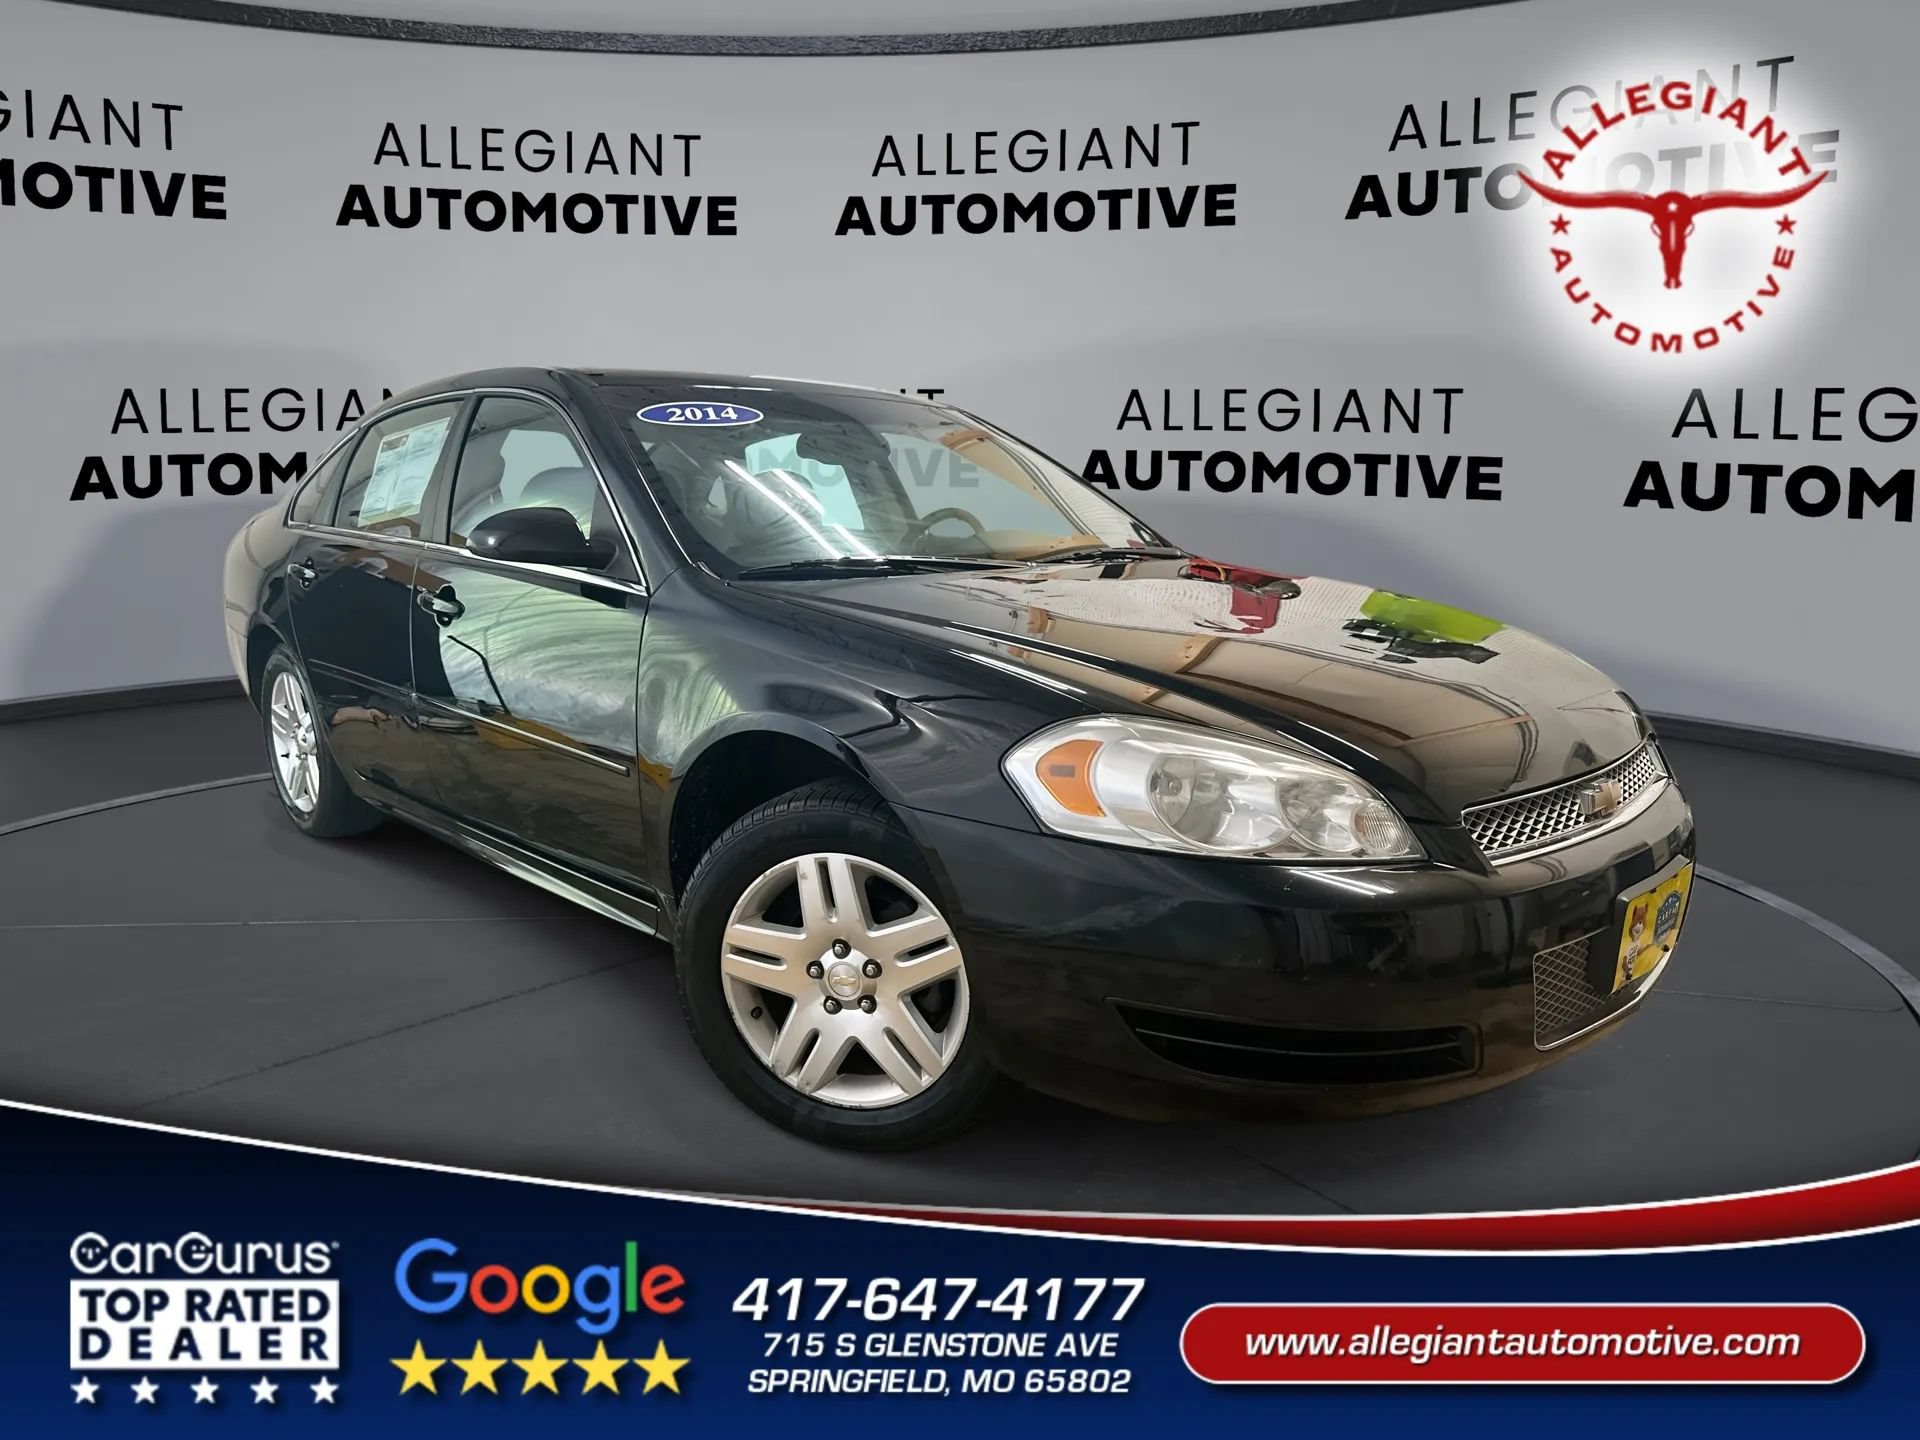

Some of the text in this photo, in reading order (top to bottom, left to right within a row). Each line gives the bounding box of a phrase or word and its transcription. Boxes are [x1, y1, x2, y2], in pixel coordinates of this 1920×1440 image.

[0, 89, 183, 151] IANT
[373, 122, 701, 177] ALLEGIANT
[871, 121, 1200, 177] ALLEGIANT
[1344, 129, 1840, 220] AUTOOTIE
[336, 184, 738, 235] AUTOMOTIVE
[834, 183, 1237, 236] AUTOMOTIVE
[111, 387, 394, 434] ALLEGIA
[666, 407, 739, 422] 2014
[1116, 388, 1465, 434] ALLEGIANT
[1671, 386, 1919, 443] ALLEG
[1082, 449, 1503, 501] AUTOMOTIVE
[1622, 460, 1916, 523] AUTOM
